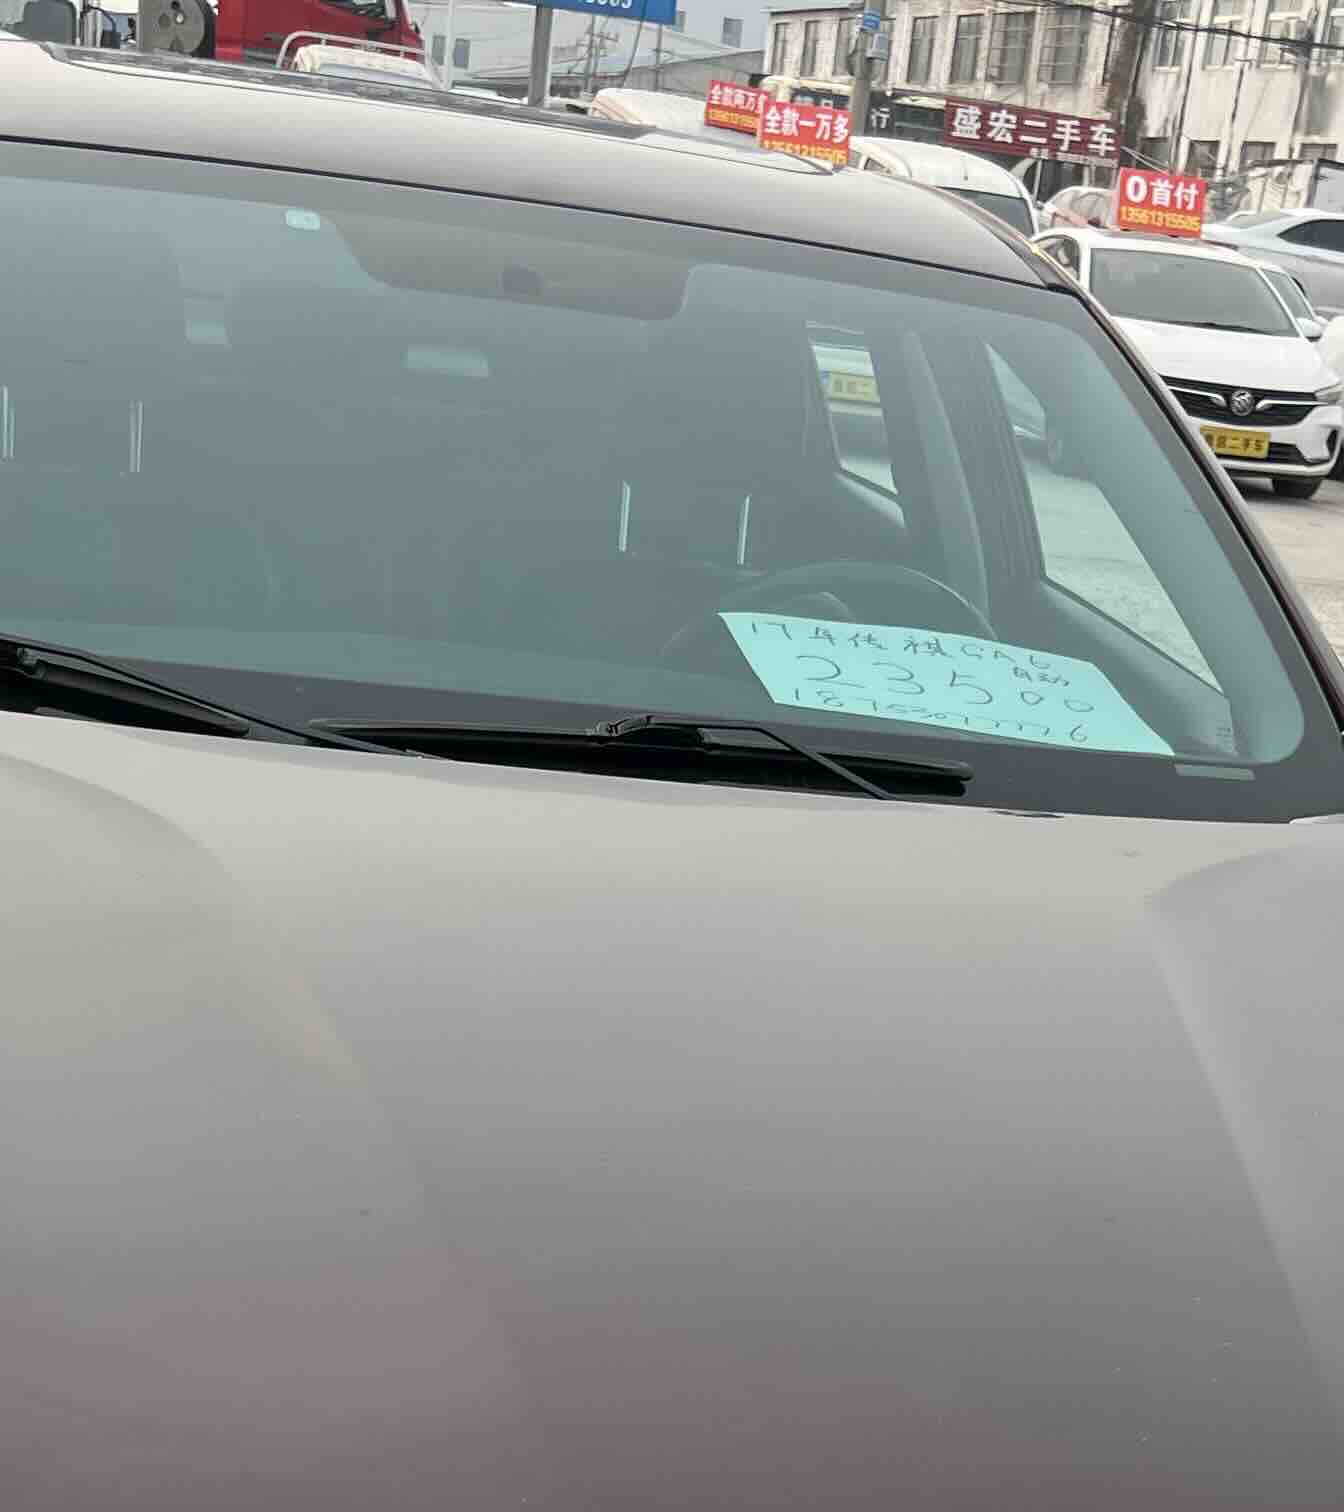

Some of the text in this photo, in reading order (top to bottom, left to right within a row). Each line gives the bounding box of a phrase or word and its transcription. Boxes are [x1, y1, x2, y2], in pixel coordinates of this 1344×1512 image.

[763, 105, 849, 144] 全款一万多
[952, 106, 1116, 157] 盛宏二手车
[1126, 175, 1200, 210] 0首付
[796, 655, 1094, 713] 23500
